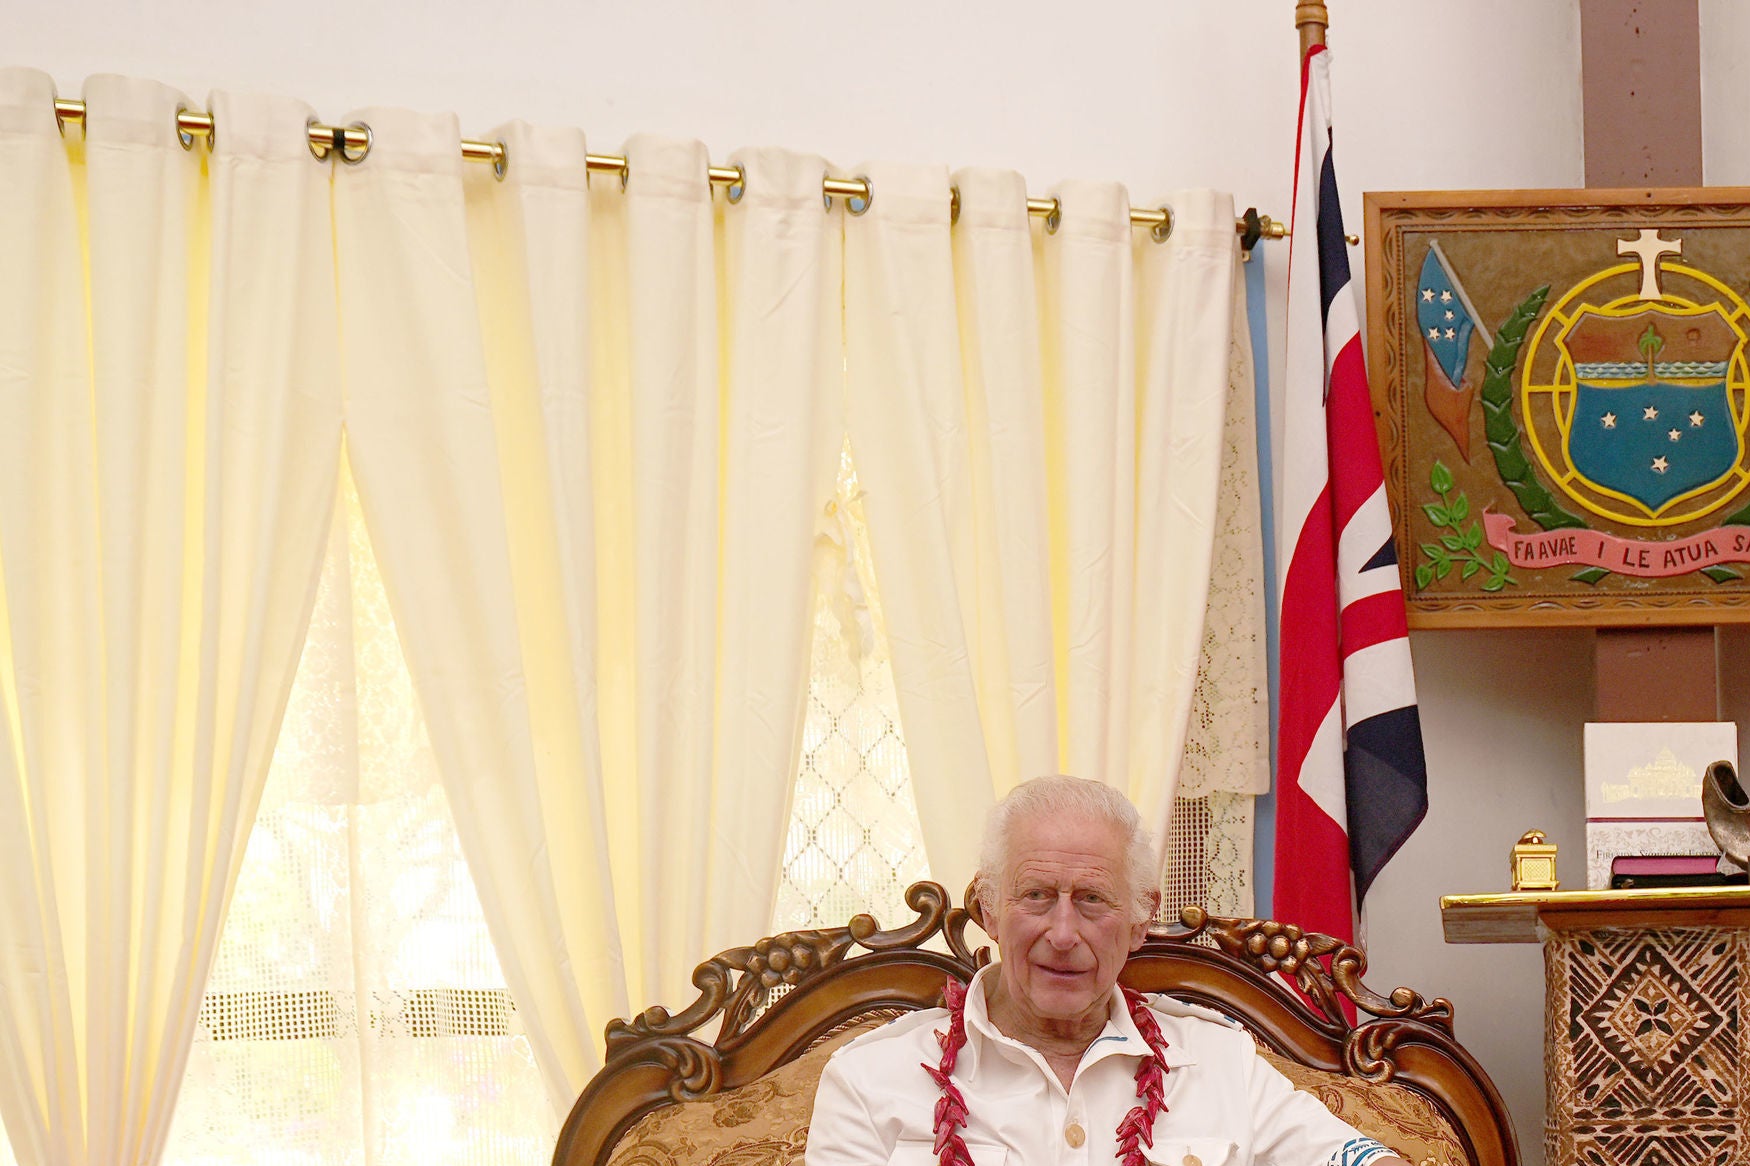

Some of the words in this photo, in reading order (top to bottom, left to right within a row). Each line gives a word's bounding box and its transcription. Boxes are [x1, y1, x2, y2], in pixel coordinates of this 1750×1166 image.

[1514, 536, 1577, 561] FAAVAE
[1598, 541, 1605, 559] I
[1622, 547, 1650, 567] LE
[1663, 539, 1719, 568] ATUA
